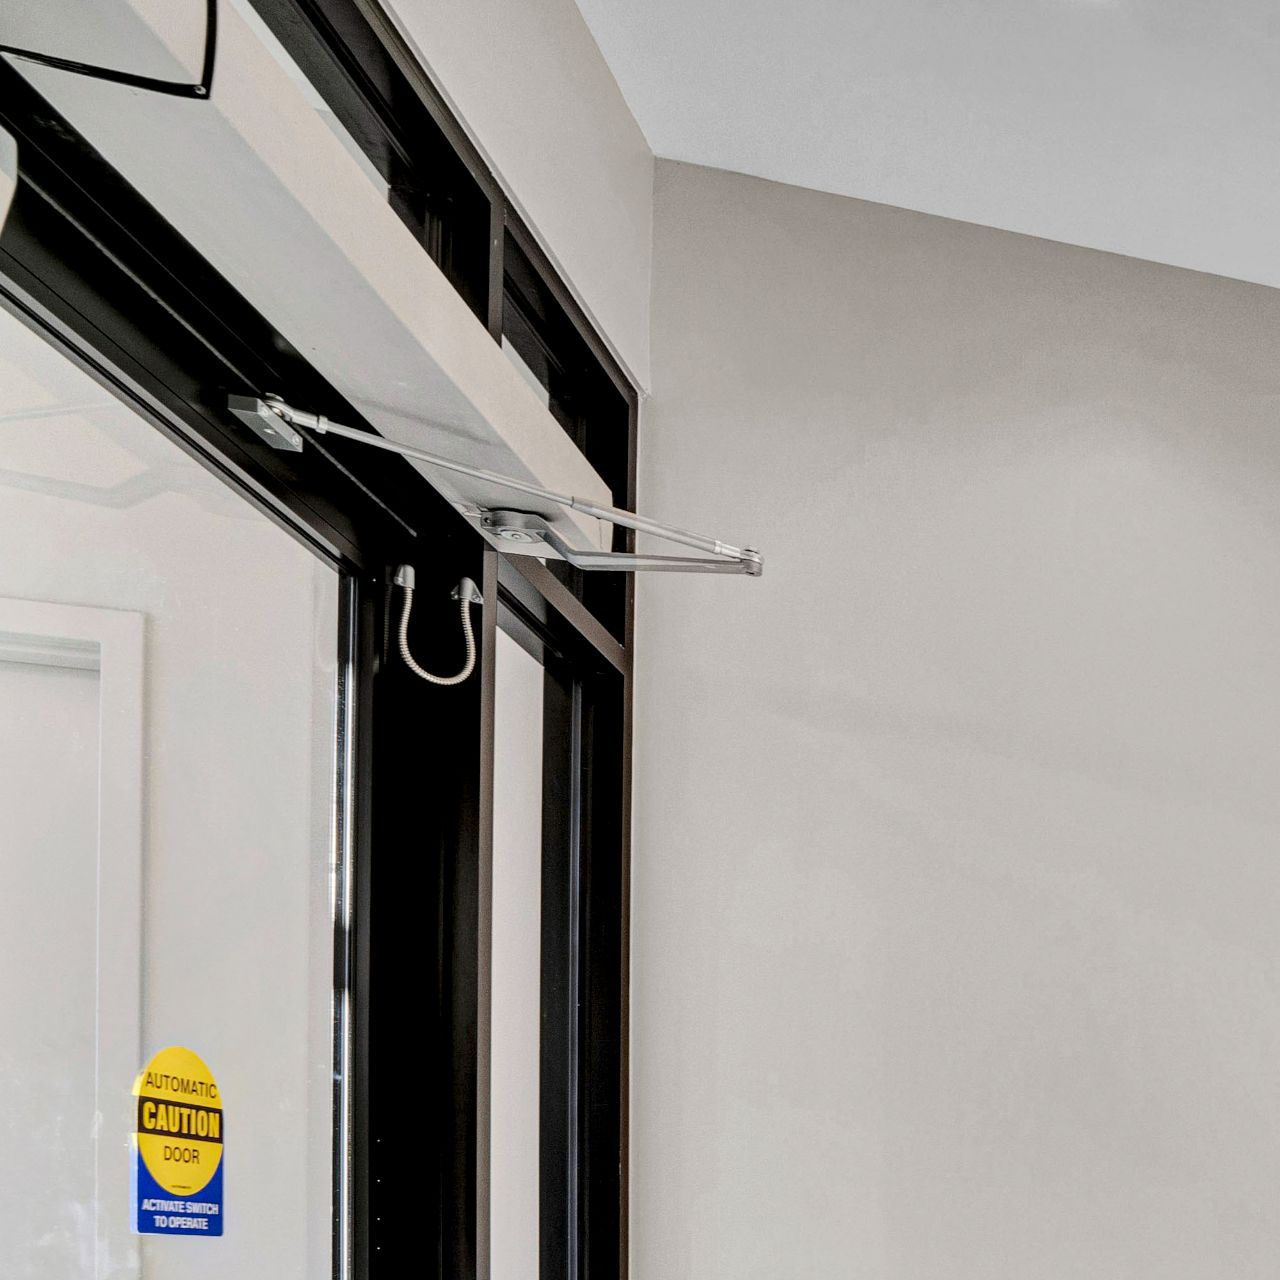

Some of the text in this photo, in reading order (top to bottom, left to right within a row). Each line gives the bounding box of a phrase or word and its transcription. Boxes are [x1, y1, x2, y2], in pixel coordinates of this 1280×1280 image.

[145, 1072, 218, 1099] AUTOMATIC
[142, 1101, 220, 1138] CAUTION
[163, 1146, 200, 1164] DOOR
[141, 1199, 219, 1215] ACTIVATE SWITCH
[153, 1215, 209, 1230] TO OPERATE
